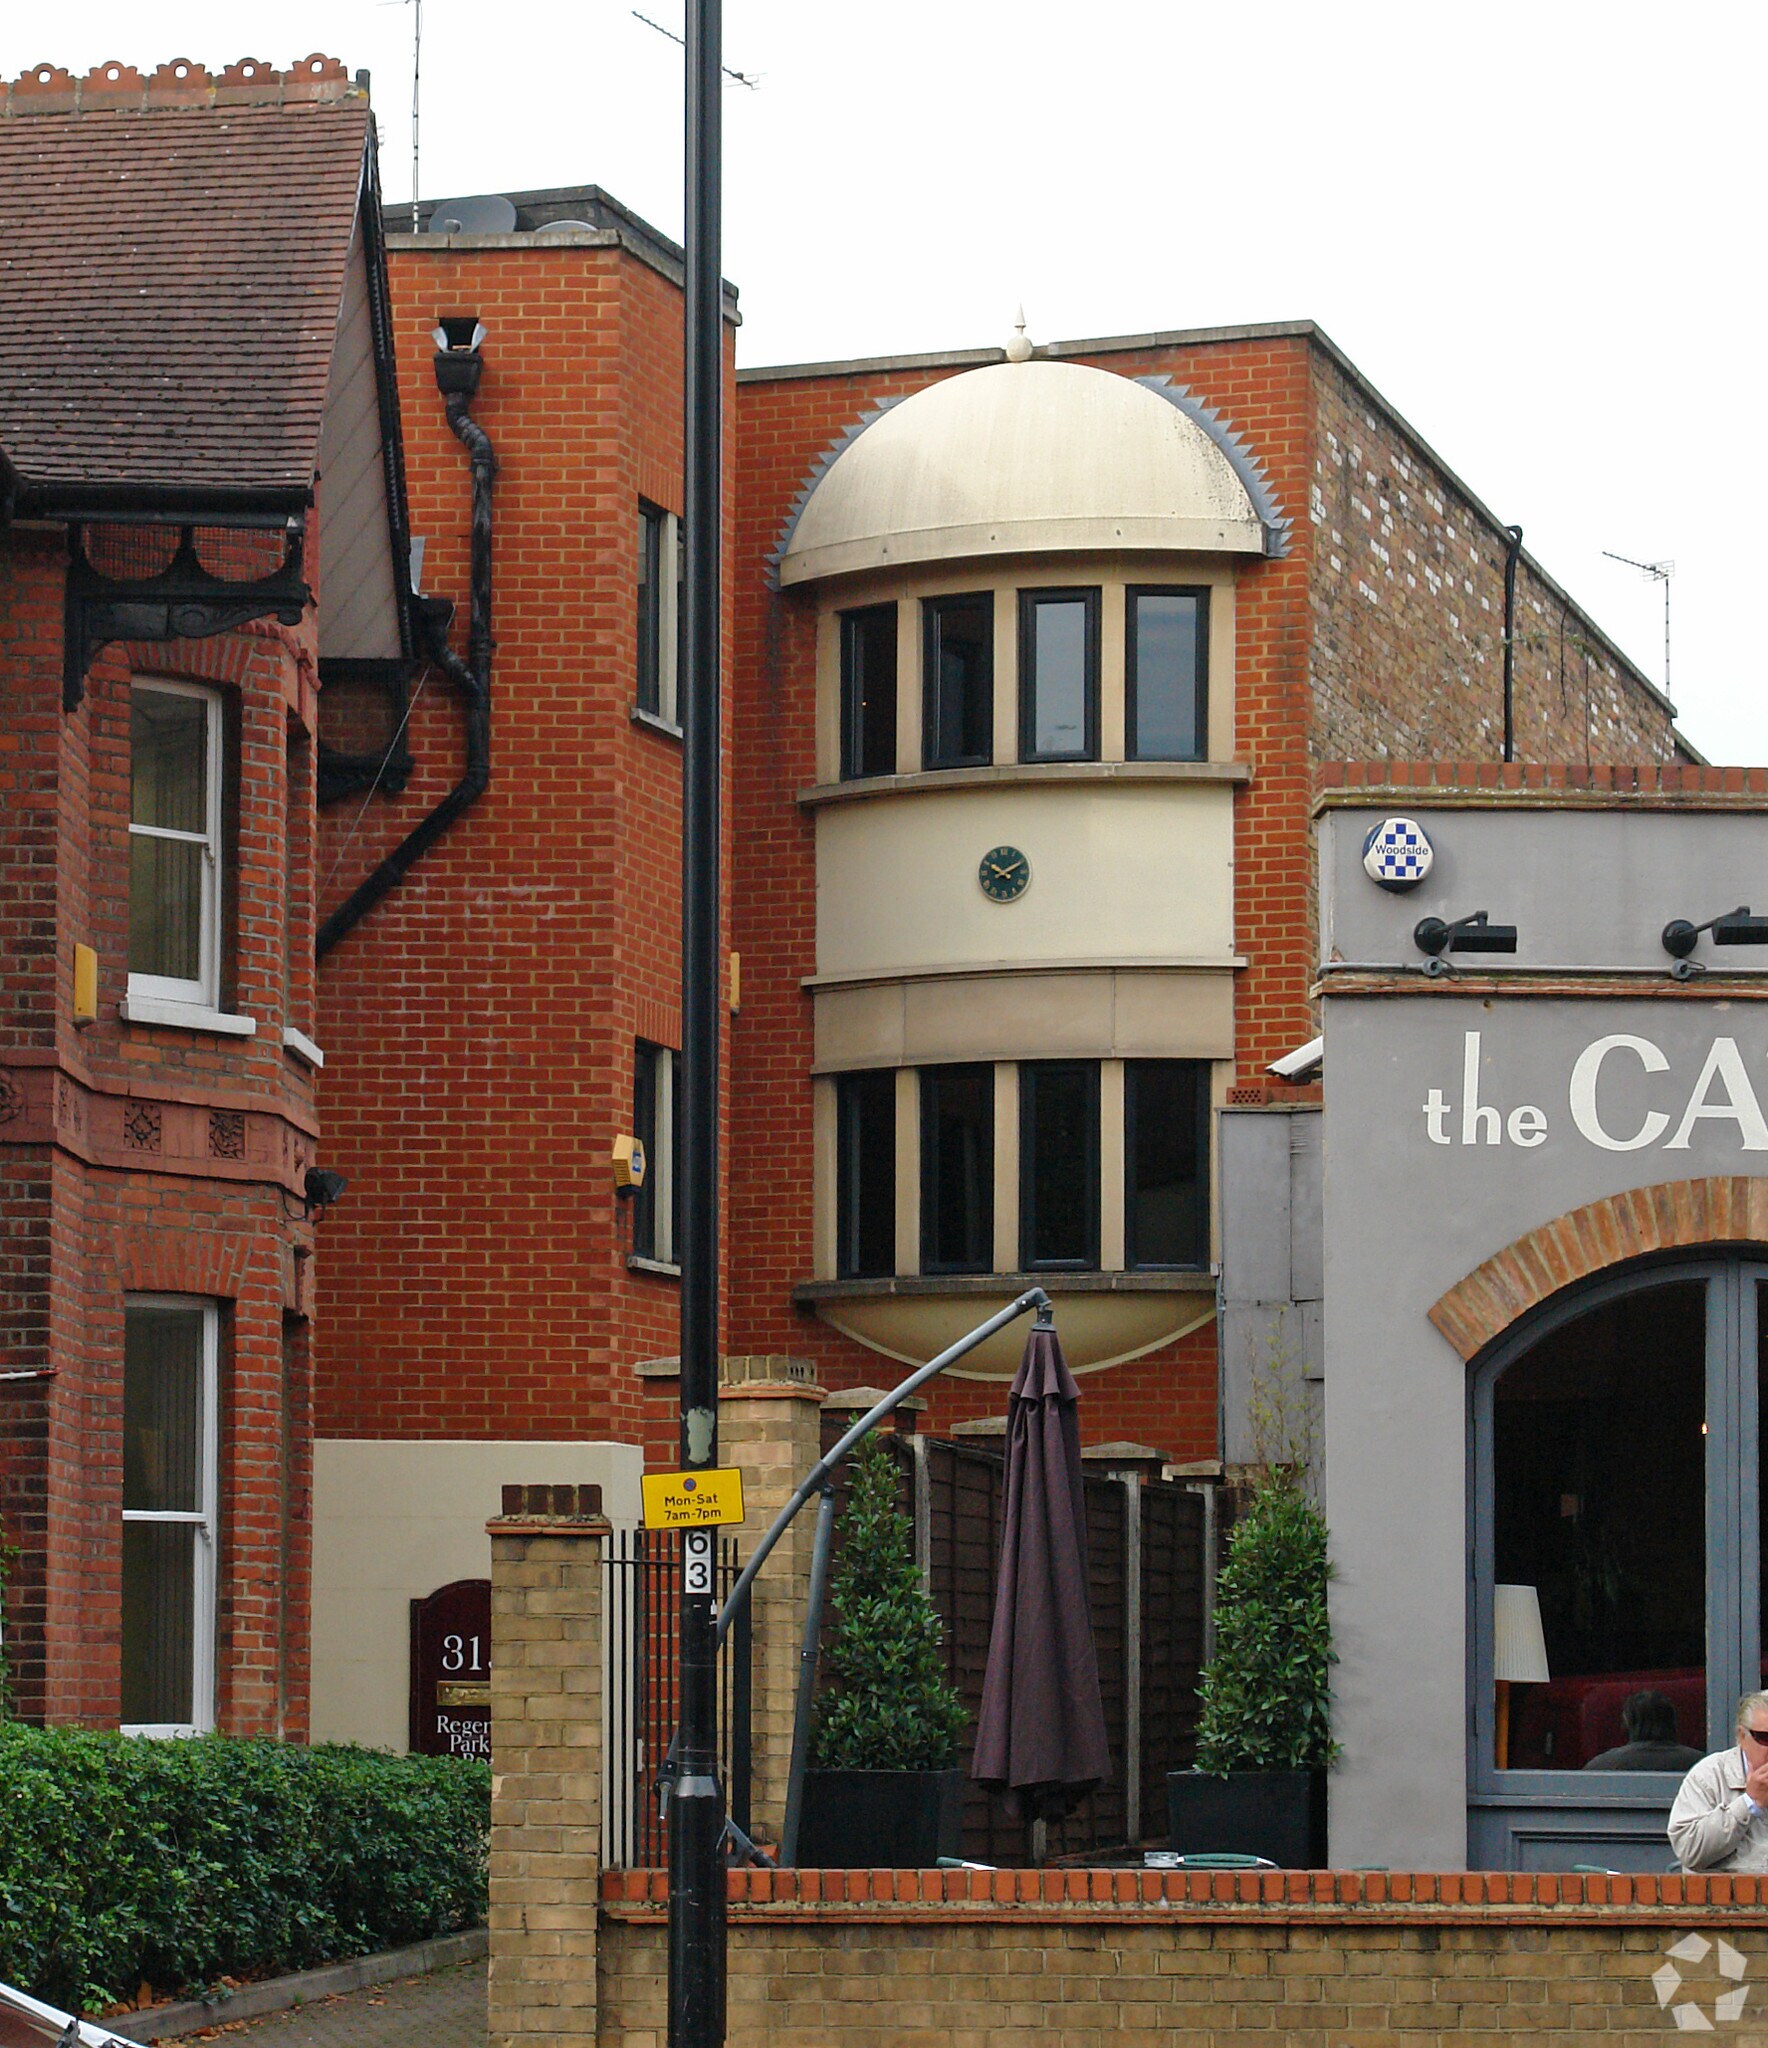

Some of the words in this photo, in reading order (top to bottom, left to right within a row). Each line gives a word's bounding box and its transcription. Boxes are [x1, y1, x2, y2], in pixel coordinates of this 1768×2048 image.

[1375, 844, 1429, 856] Woodside
[1421, 1031, 1548, 1148] the
[1569, 1033, 1768, 1151] CA
[664, 1493, 719, 1507] Mon-Sat
[664, 1507, 721, 1521] 7am-7pm
[442, 1634, 492, 1671] 31
[450, 1734, 490, 1753] Park
